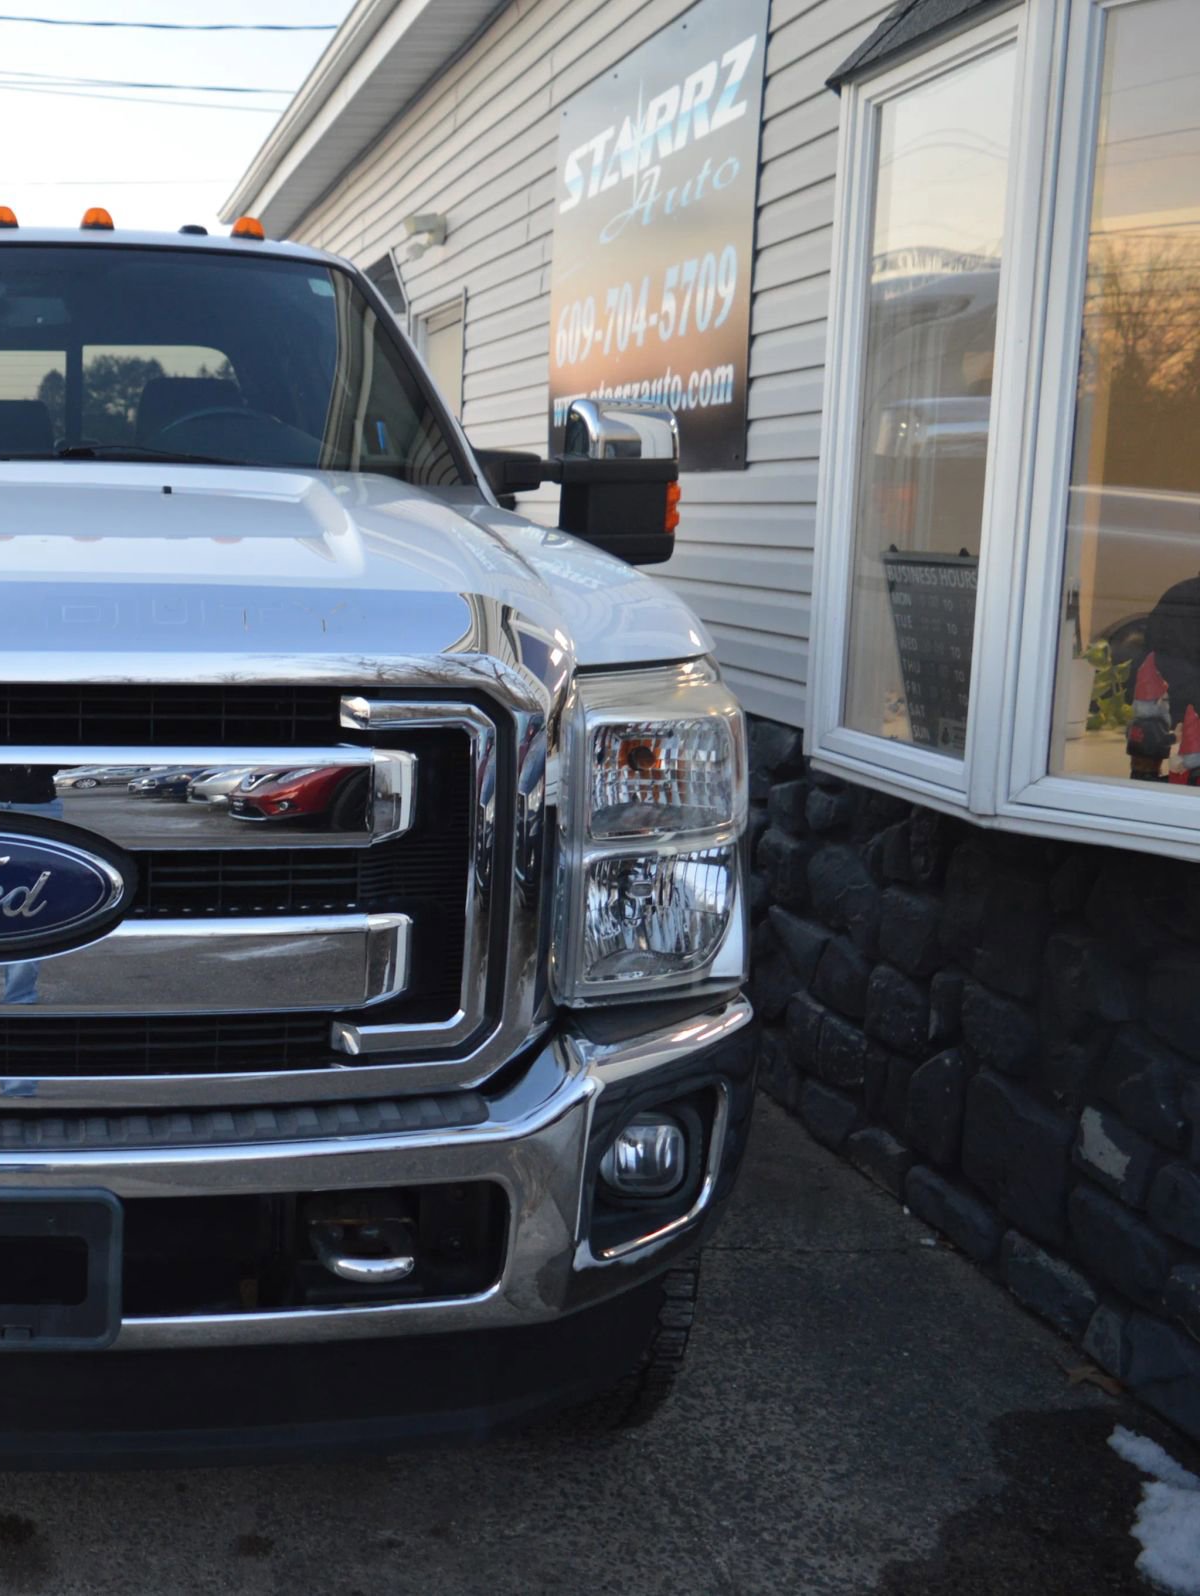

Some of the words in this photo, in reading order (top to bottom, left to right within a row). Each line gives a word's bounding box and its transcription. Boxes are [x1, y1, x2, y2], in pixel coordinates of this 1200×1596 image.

[559, 34, 757, 213] STARRZ
[600, 157, 740, 244] Auto
[555, 245, 738, 369] 609-704-5709
[45, 597, 360, 632] DUTY
[887, 564, 938, 585] BUSINESS
[940, 568, 978, 590] HOURS
